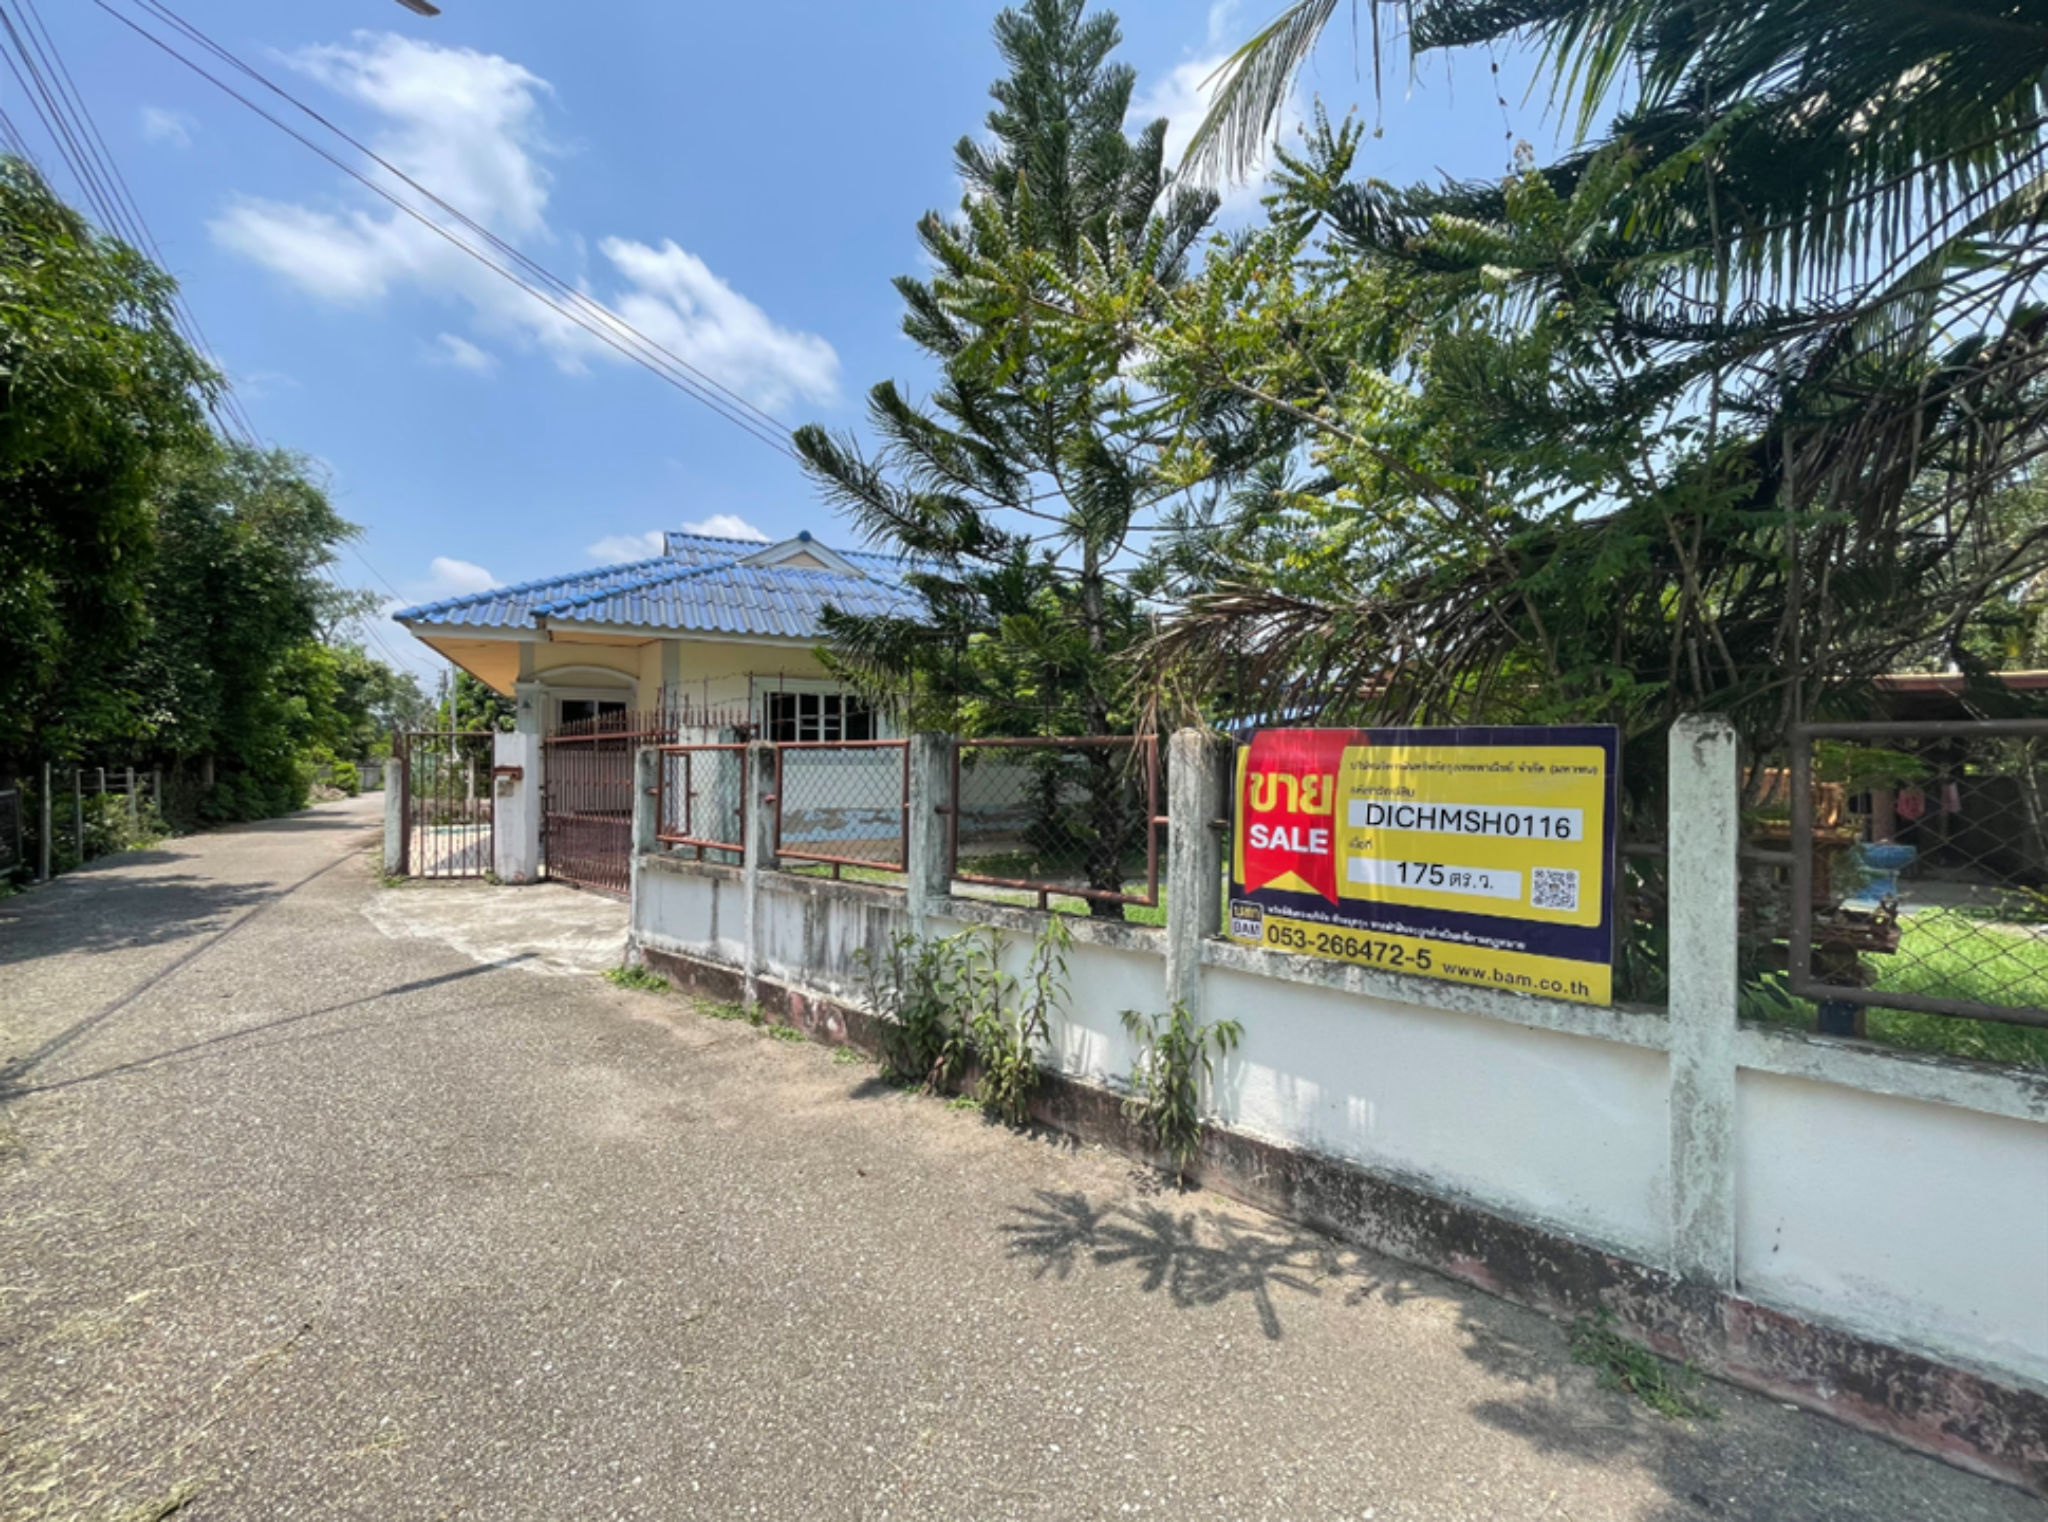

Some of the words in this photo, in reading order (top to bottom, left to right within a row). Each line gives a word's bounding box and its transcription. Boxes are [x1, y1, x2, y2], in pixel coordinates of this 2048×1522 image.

[1250, 771, 1333, 815] ขาย
[1249, 822, 1329, 854] SALE
[1365, 802, 1571, 839] DICHMSH0116
[1397, 861, 1445, 886] 175
[1267, 923, 1432, 970] 053-266472-5
[1442, 962, 1590, 998] www.bam.co.th
